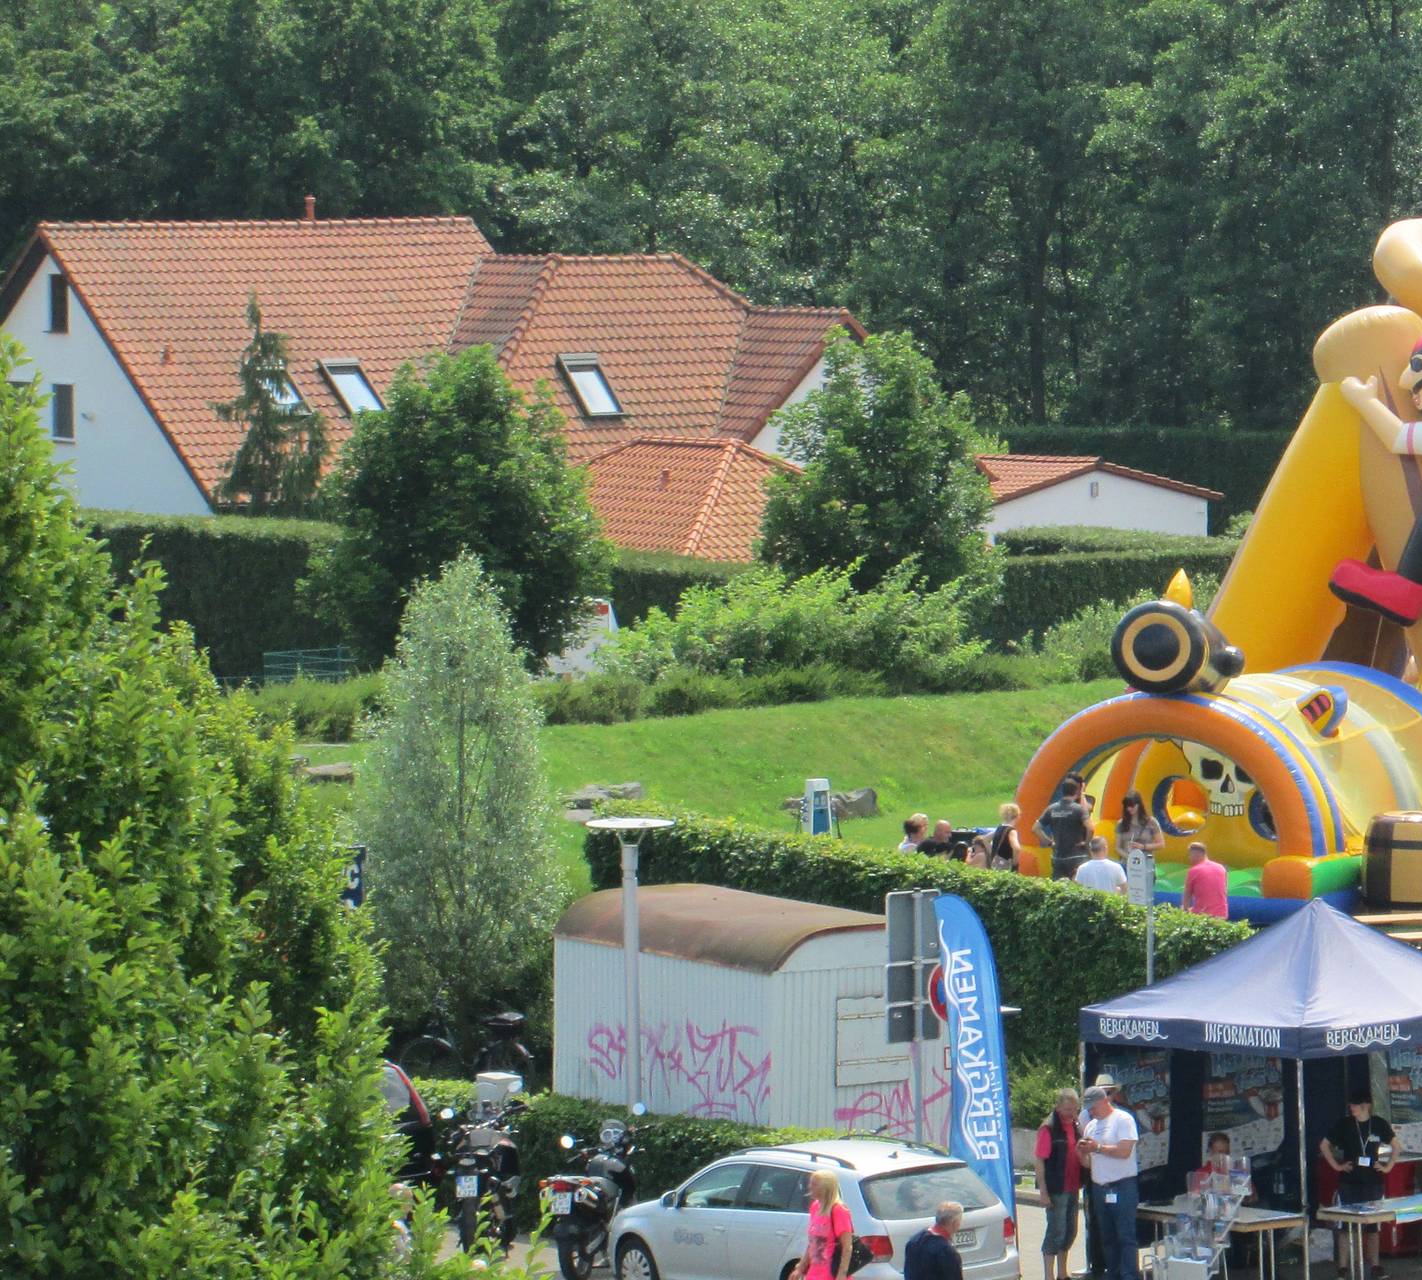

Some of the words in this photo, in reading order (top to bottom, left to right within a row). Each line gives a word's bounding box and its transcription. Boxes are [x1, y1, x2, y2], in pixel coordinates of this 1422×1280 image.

[1100, 1018, 1159, 1036] BERGKAMEN
[1204, 1023, 1281, 1048] INFORMATION
[1326, 1023, 1400, 1046] BERGKAMEN
